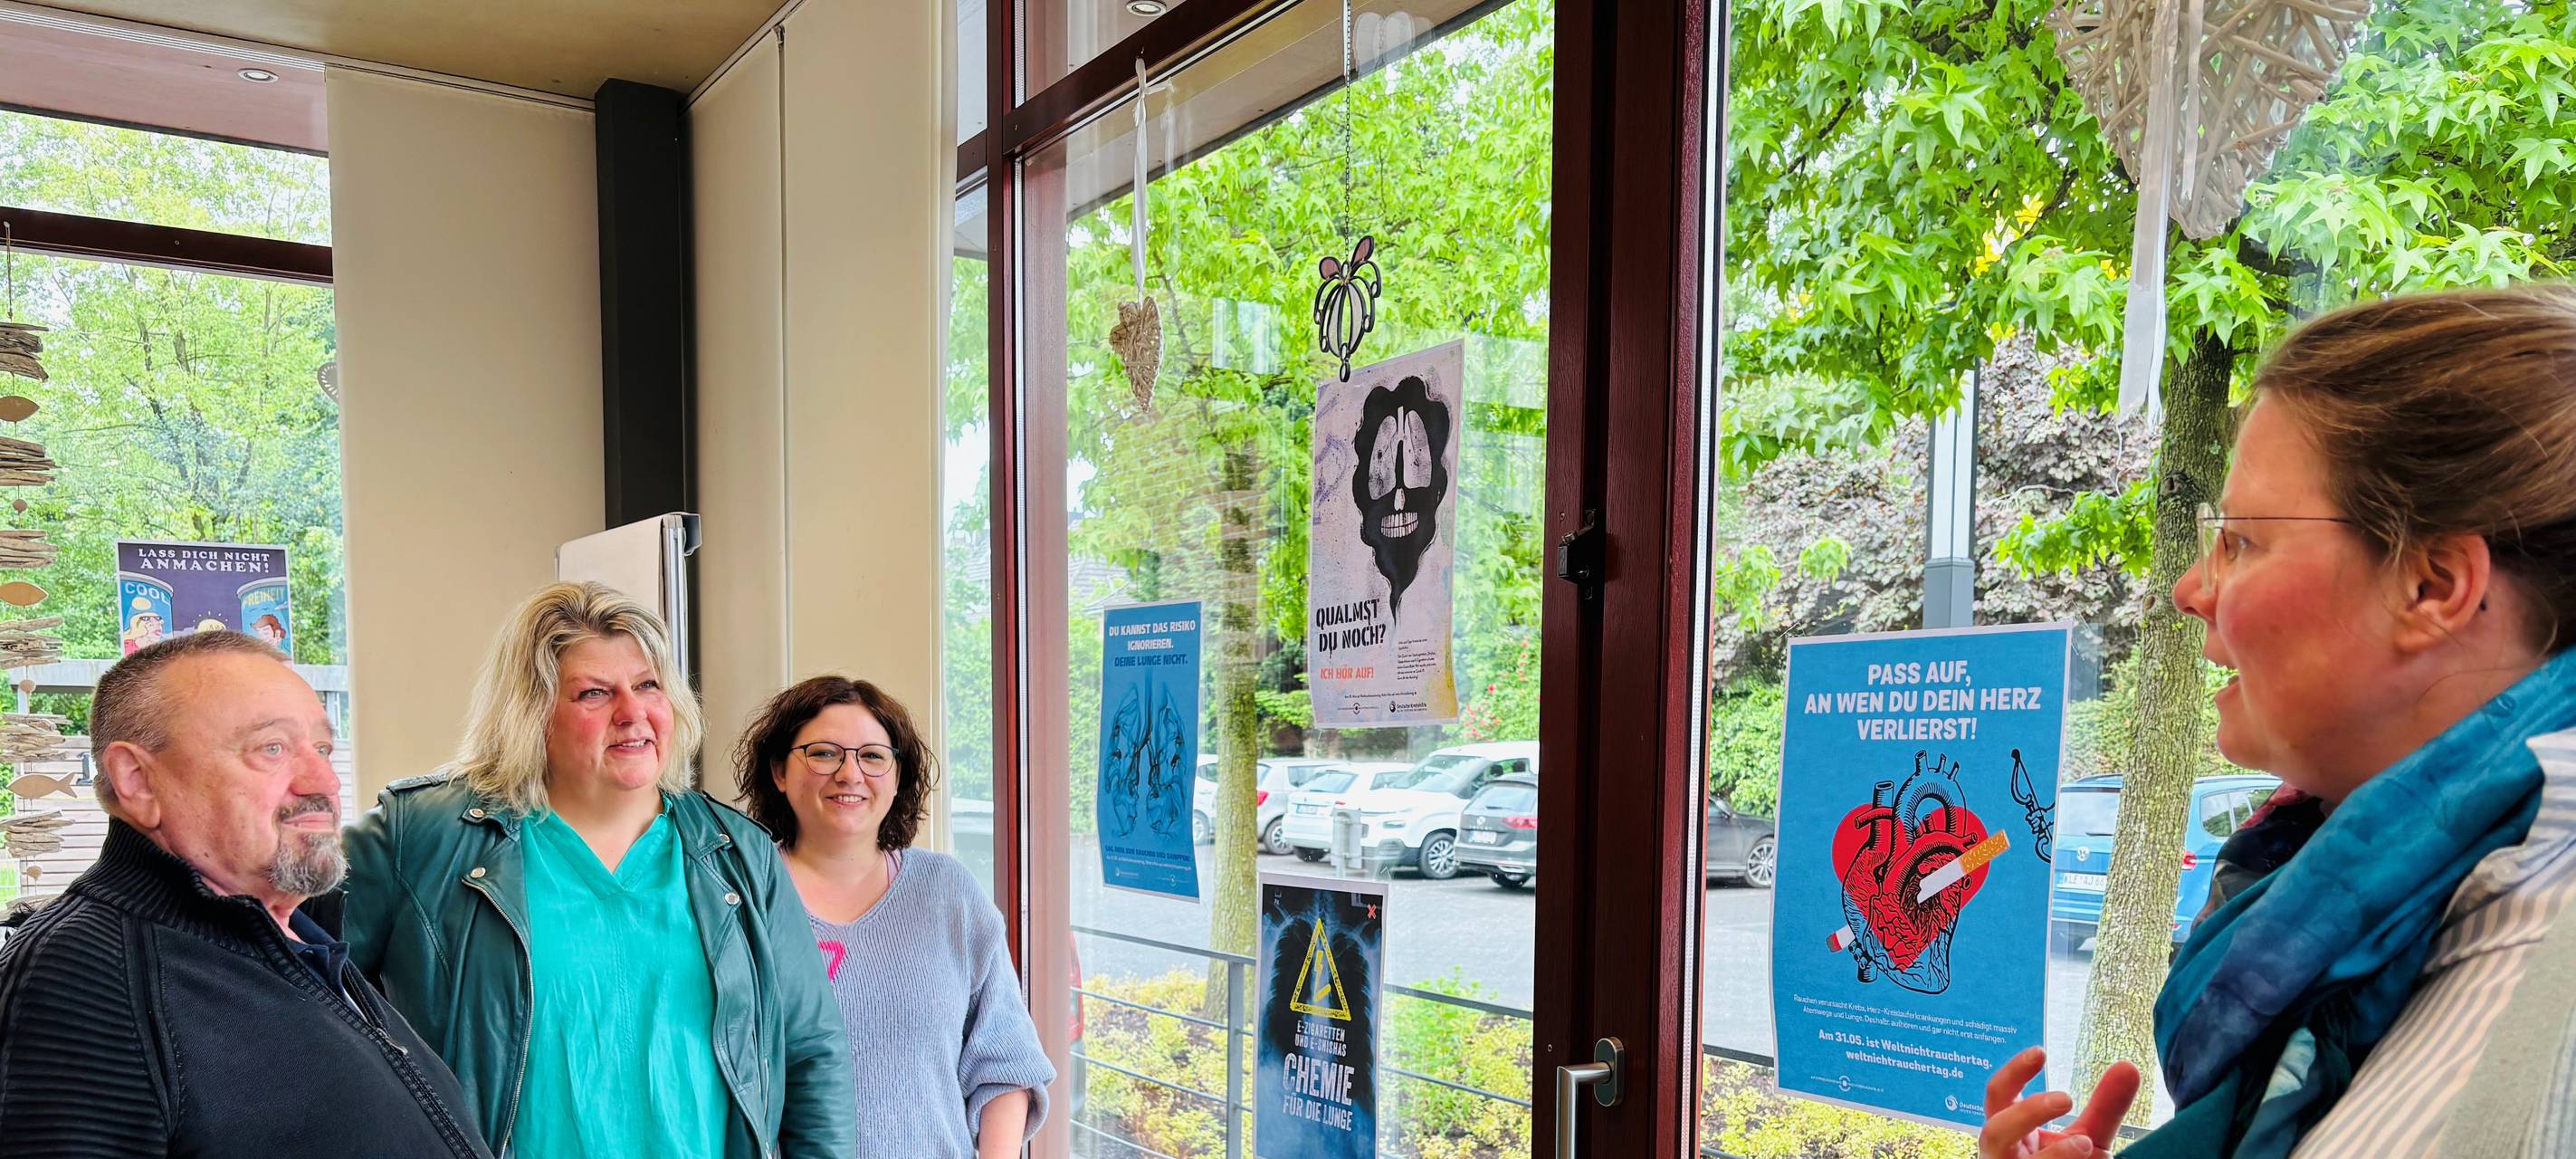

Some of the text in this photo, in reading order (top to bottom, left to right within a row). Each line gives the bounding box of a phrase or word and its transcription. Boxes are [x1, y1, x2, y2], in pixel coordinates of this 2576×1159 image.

[138, 549, 270, 562] LASS DICH NICHT
[140, 558, 270, 573] ANMACHEN!
[125, 581, 171, 605] COOL
[1316, 599, 1379, 630] QUALMST
[1109, 619, 1197, 637] DU KANNST DAS RISIKO
[1319, 631, 1338, 654] DU
[1341, 623, 1387, 649] NOCH?
[1128, 637, 1174, 651] IGNORIEREN.
[1114, 652, 1188, 667] DEINE LUNGE NICHT.
[1320, 664, 1374, 679] ICH HÖR AUF!
[1867, 660, 1971, 686] PASS AUF,
[1804, 686, 2042, 714] AN WEN DU DEIN HERZ
[1857, 717, 1978, 741] VERLIERST!
[1794, 994, 1818, 1005] Rauchen
[1818, 999, 1847, 1009] verursacht
[1951, 1018, 1964, 1027] und
[1964, 1020, 1991, 1032] schädigt
[1993, 1024, 2017, 1034] massiv
[1803, 1006, 1832, 1018] Atemwege
[1891, 1020, 1919, 1030] aufhören
[1943, 1027, 1959, 1036] nicht
[1961, 1030, 1973, 1039] erst
[1974, 1032, 2006, 1044] anfangen.
[1296, 1020, 1345, 1043] E-ZIGARETTEN
[1294, 1034, 1347, 1058] UND E-SHISHAS
[1818, 1029, 1993, 1069] Am 31.05. ist Weltnichtrauchertag.
[1846, 1050, 1964, 1078] weltnichtrauchertag.de
[1283, 1052, 1355, 1106] CHEMIE
[1283, 1092, 1353, 1132] FÜR DIE LUNGE
